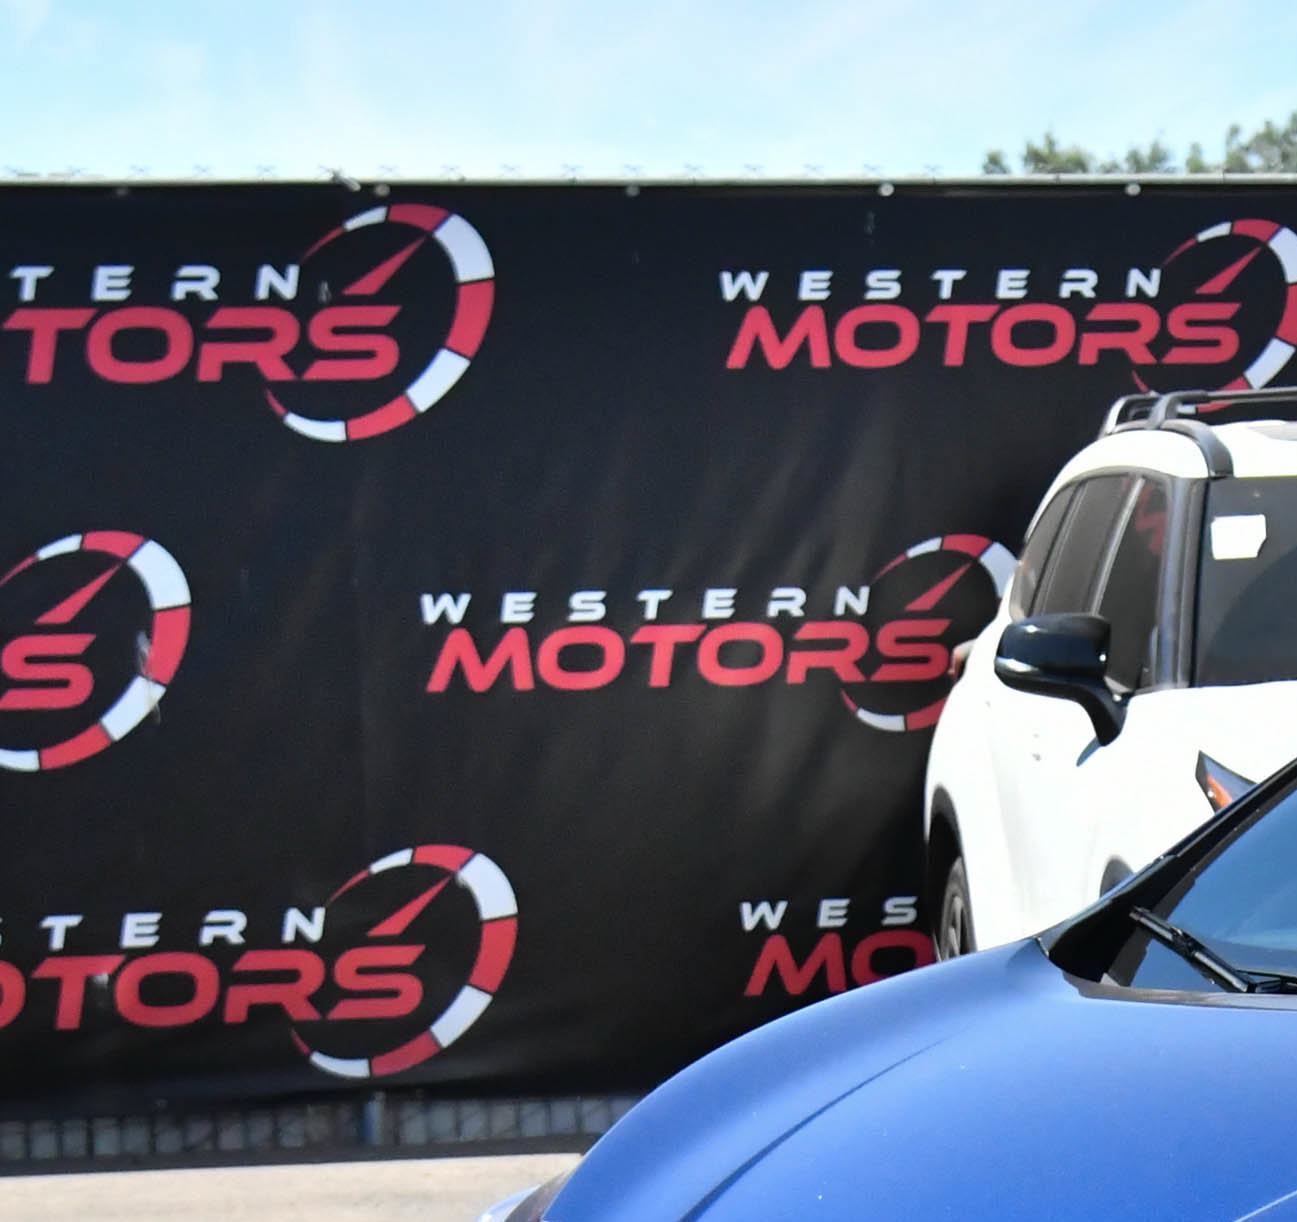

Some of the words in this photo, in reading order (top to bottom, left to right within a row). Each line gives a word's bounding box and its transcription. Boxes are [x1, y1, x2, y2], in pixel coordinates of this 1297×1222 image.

[11, 265, 300, 301] TERN
[720, 268, 1161, 301] WESTERN
[3, 306, 402, 384] TORS
[726, 302, 1241, 369] MOTORS
[420, 586, 870, 624] WESTERN
[427, 619, 950, 692] MOTORS
[0, 908, 326, 951] TERN
[740, 897, 917, 931] WES
[744, 930, 935, 996] MO
